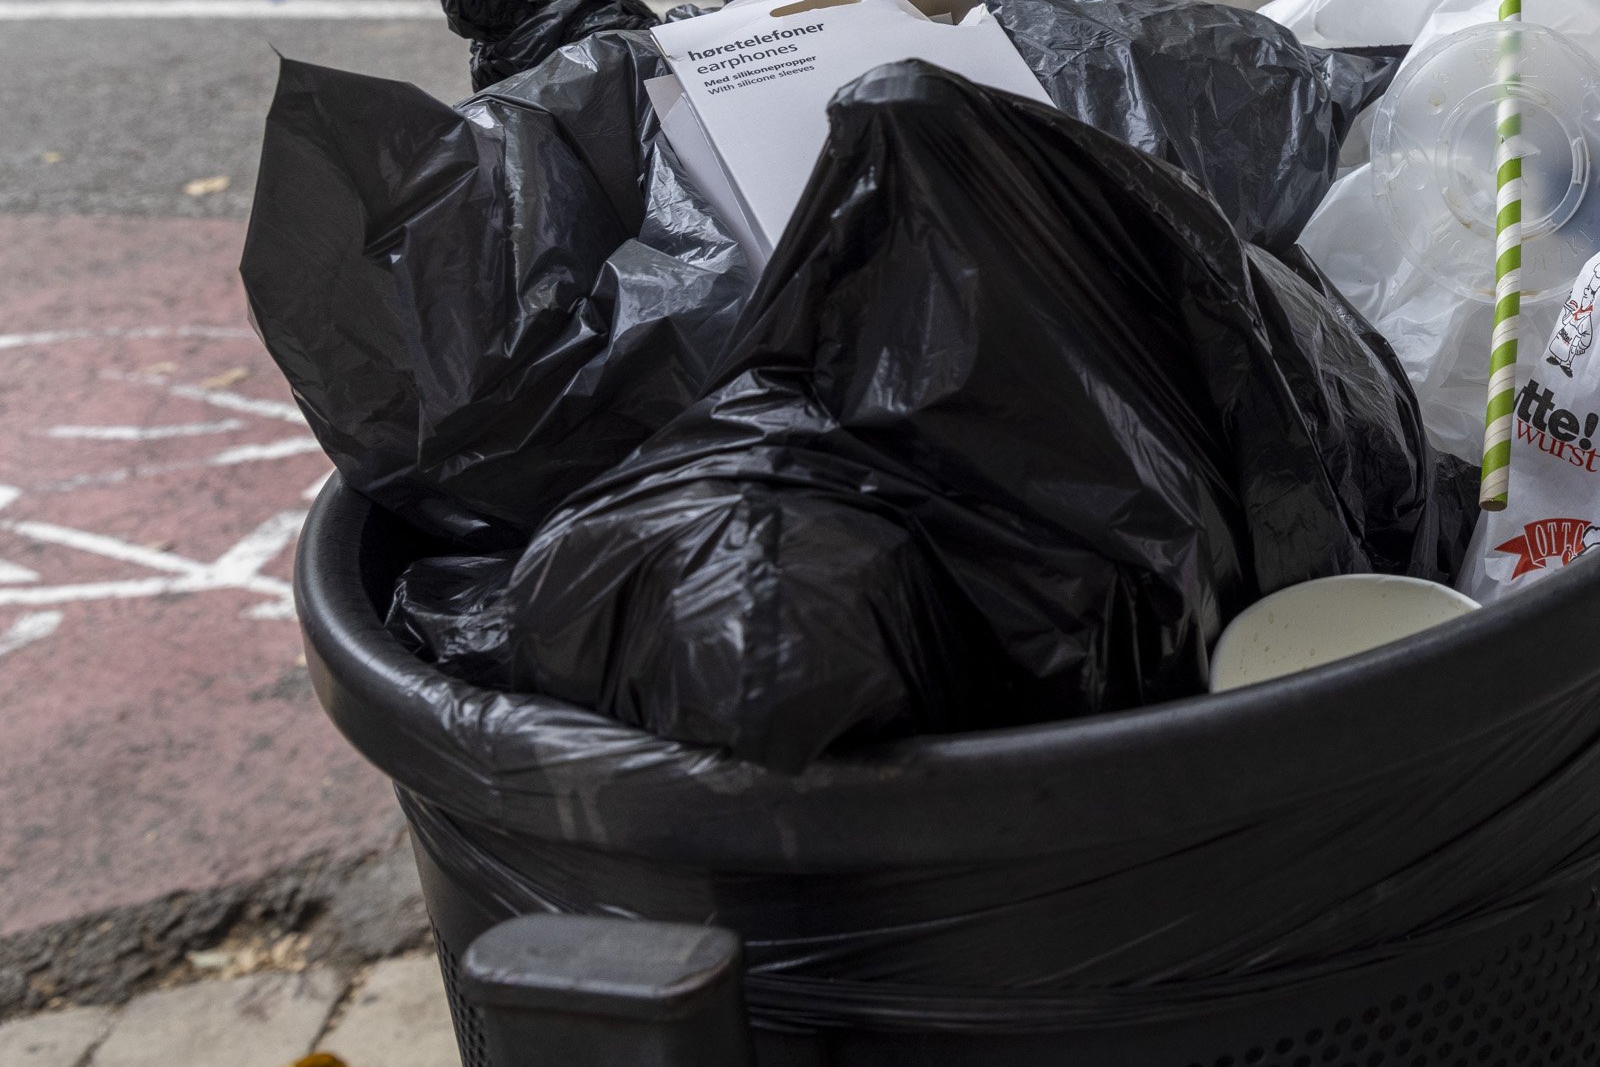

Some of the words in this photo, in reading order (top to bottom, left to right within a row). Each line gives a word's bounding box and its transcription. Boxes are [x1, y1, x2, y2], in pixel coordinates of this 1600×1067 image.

[688, 22, 825, 62] høretelefoner
[697, 42, 798, 75] earphones
[704, 75, 730, 88] Med
[733, 55, 817, 81] silikonepropper
[707, 84, 735, 96] With
[737, 74, 776, 88] silicone
[779, 65, 815, 79] sleeves
[1516, 418, 1600, 473] wurst
